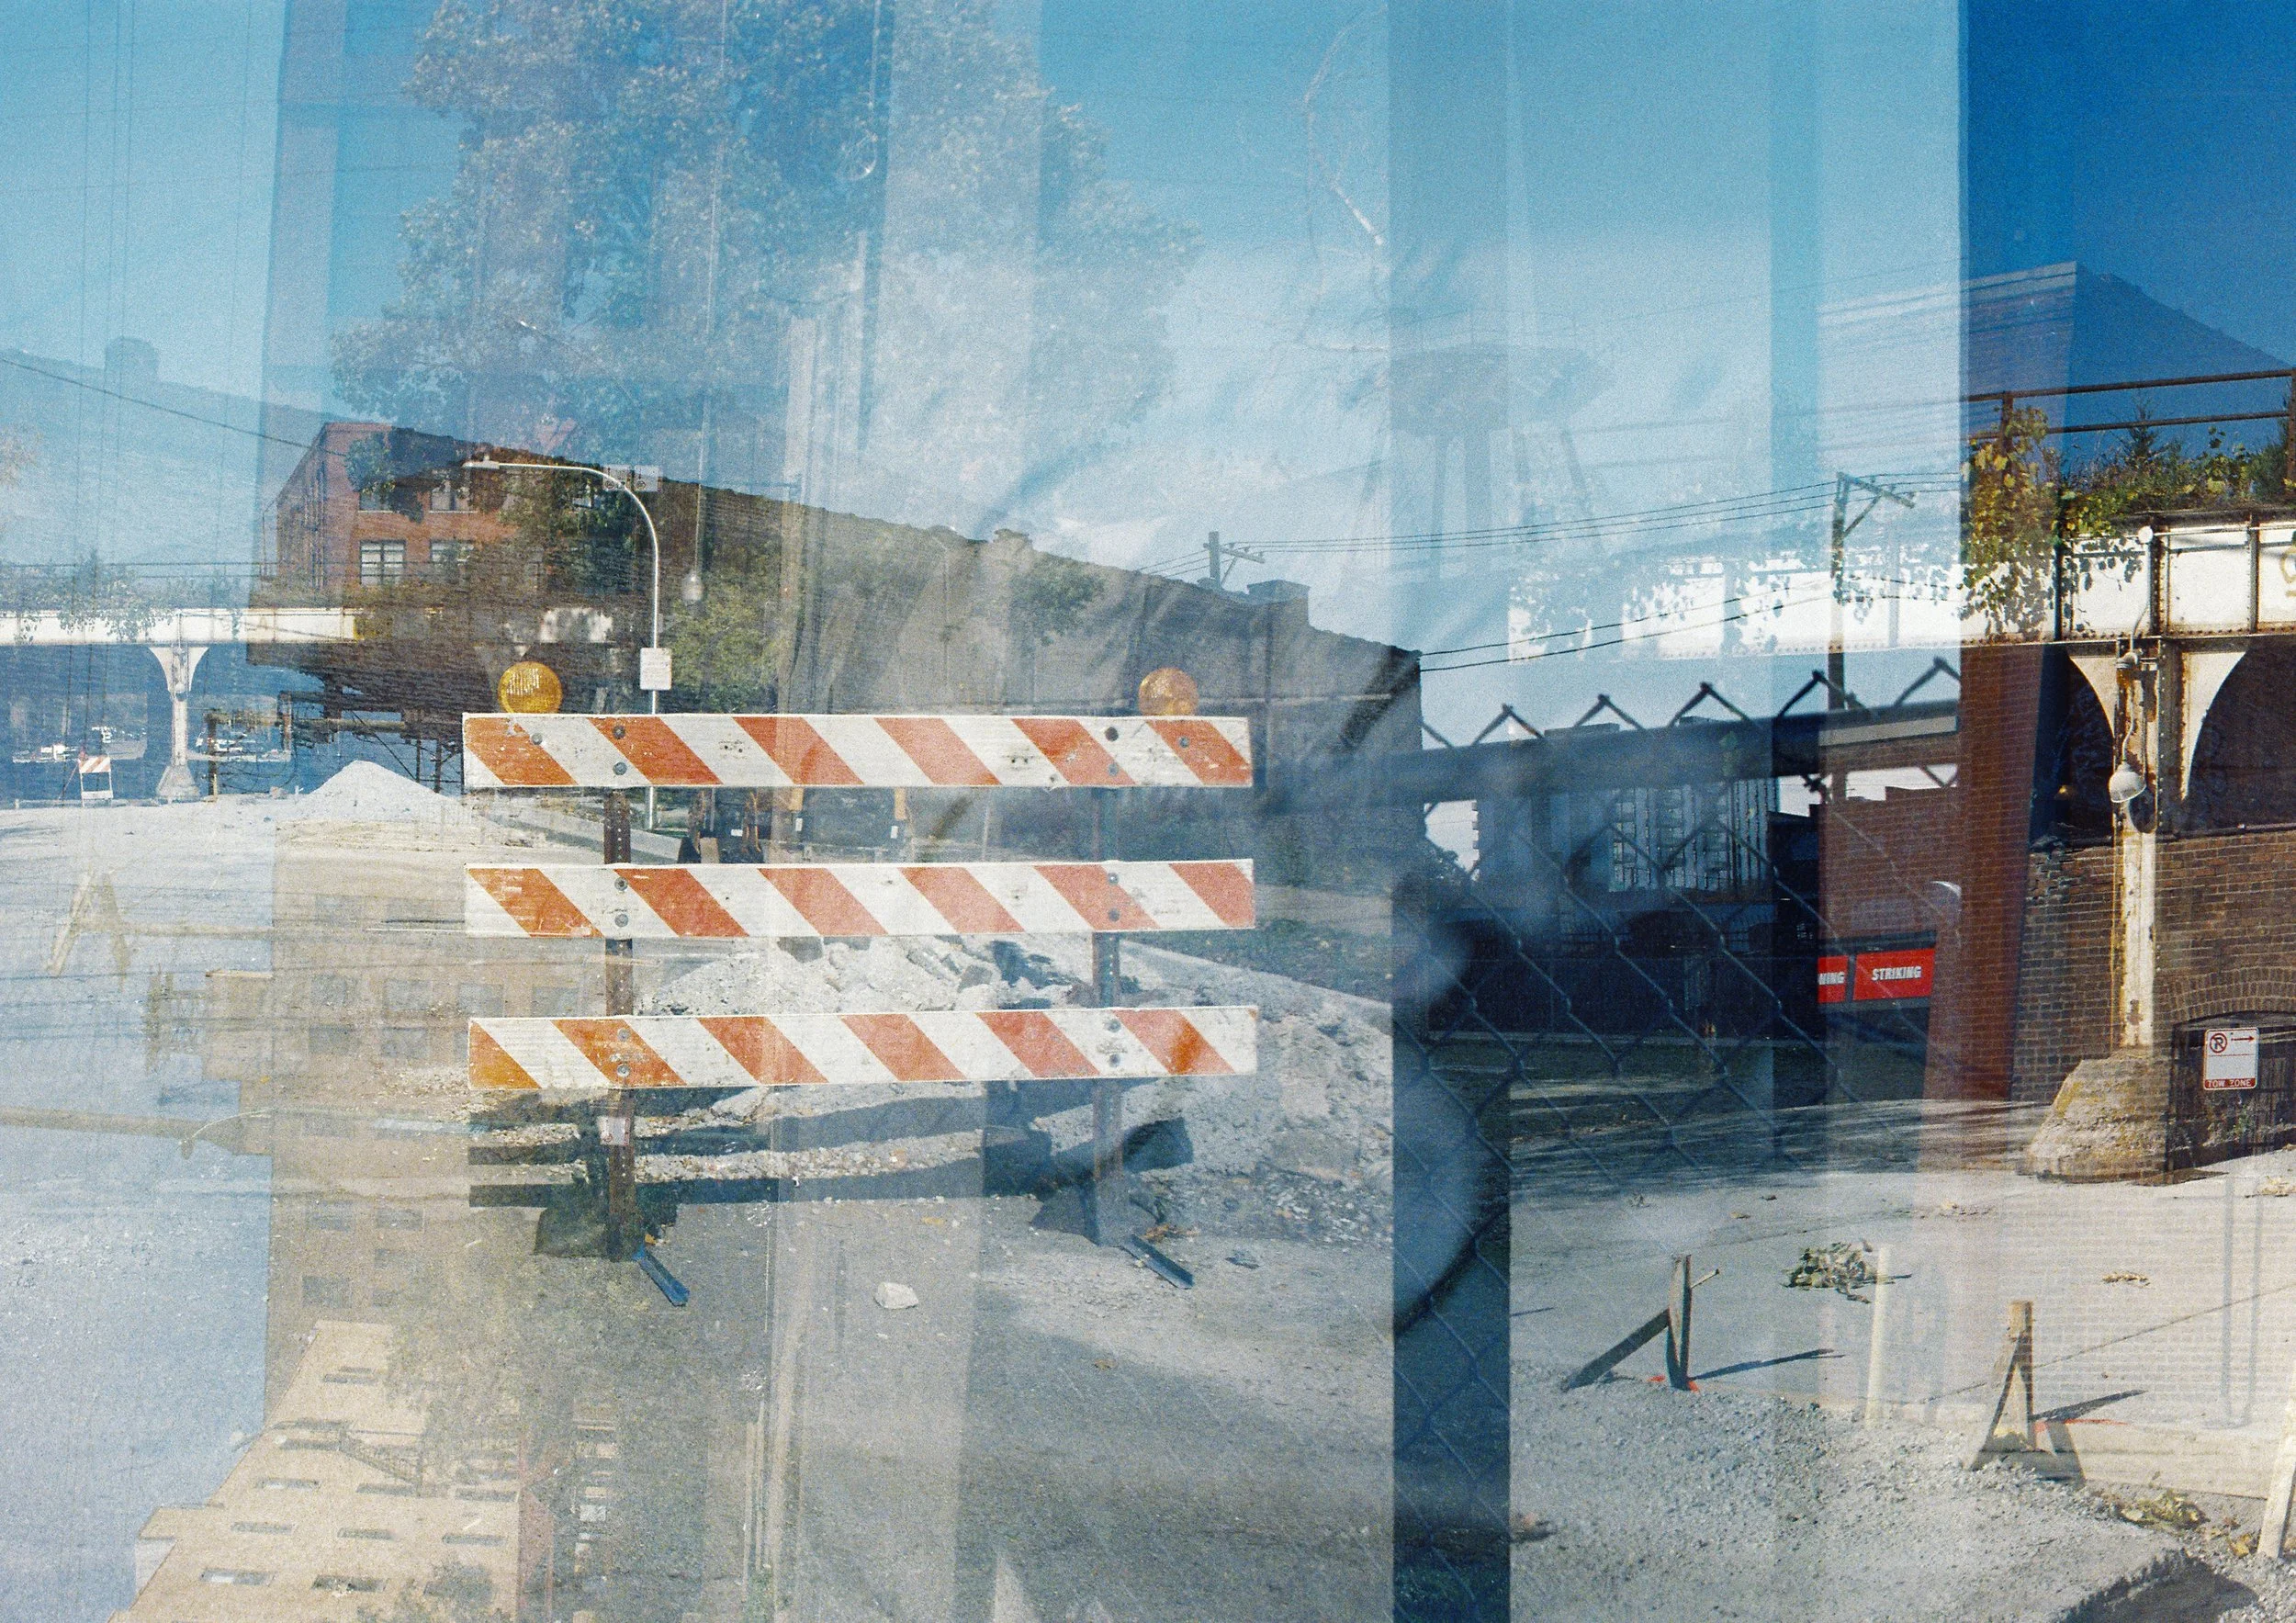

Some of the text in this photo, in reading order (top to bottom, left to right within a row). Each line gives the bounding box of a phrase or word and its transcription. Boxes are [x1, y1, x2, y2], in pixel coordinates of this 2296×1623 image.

[1872, 966, 1922, 981] STRIKING
[2207, 1078, 2252, 1088] TOW ZONE
